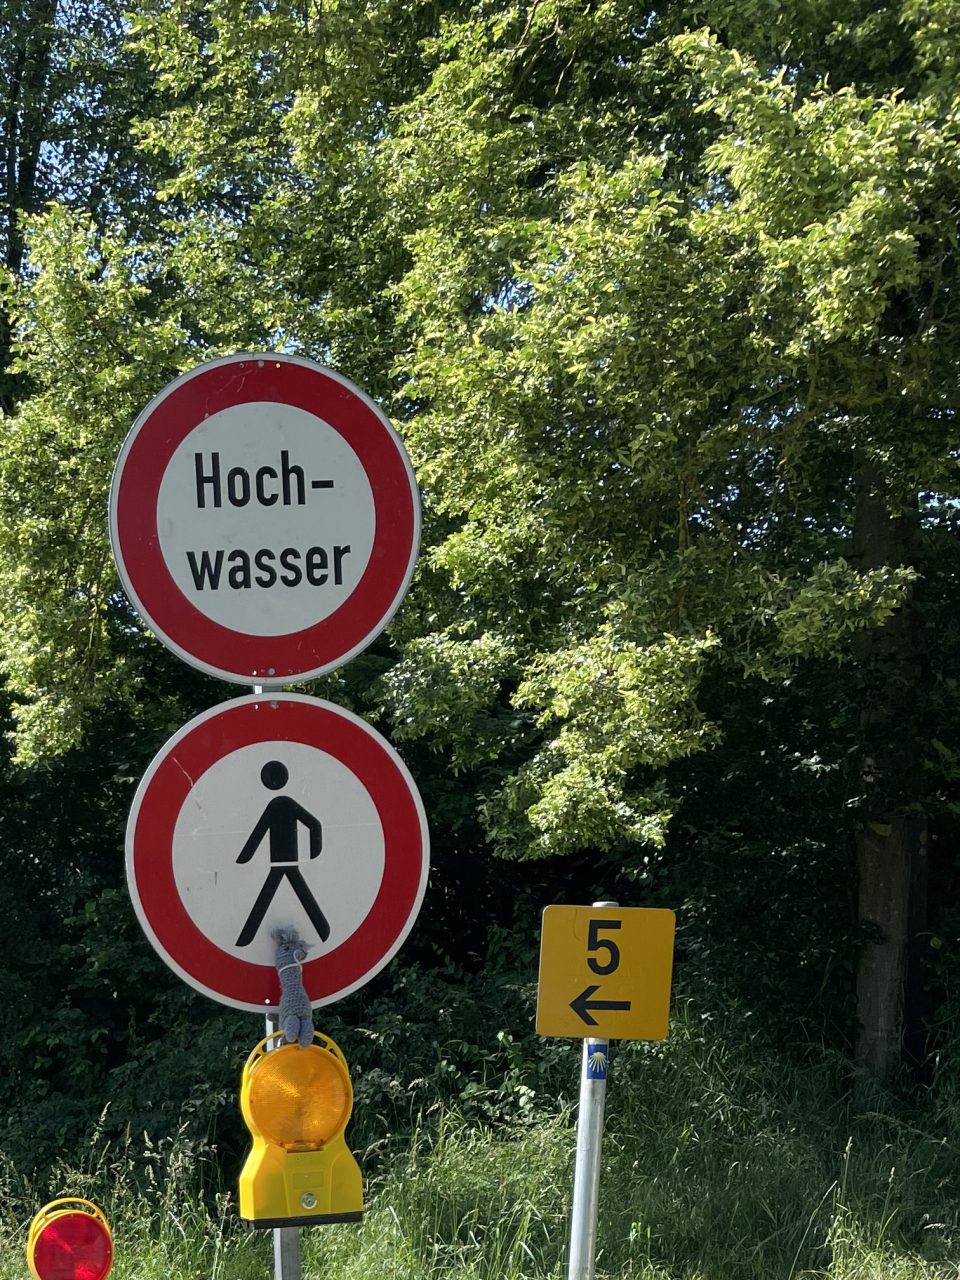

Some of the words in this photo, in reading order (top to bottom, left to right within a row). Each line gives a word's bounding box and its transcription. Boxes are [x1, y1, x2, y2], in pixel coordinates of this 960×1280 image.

[195, 450, 334, 509] Hoch-
[186, 544, 351, 591] wasser
[587, 919, 622, 976] 5
